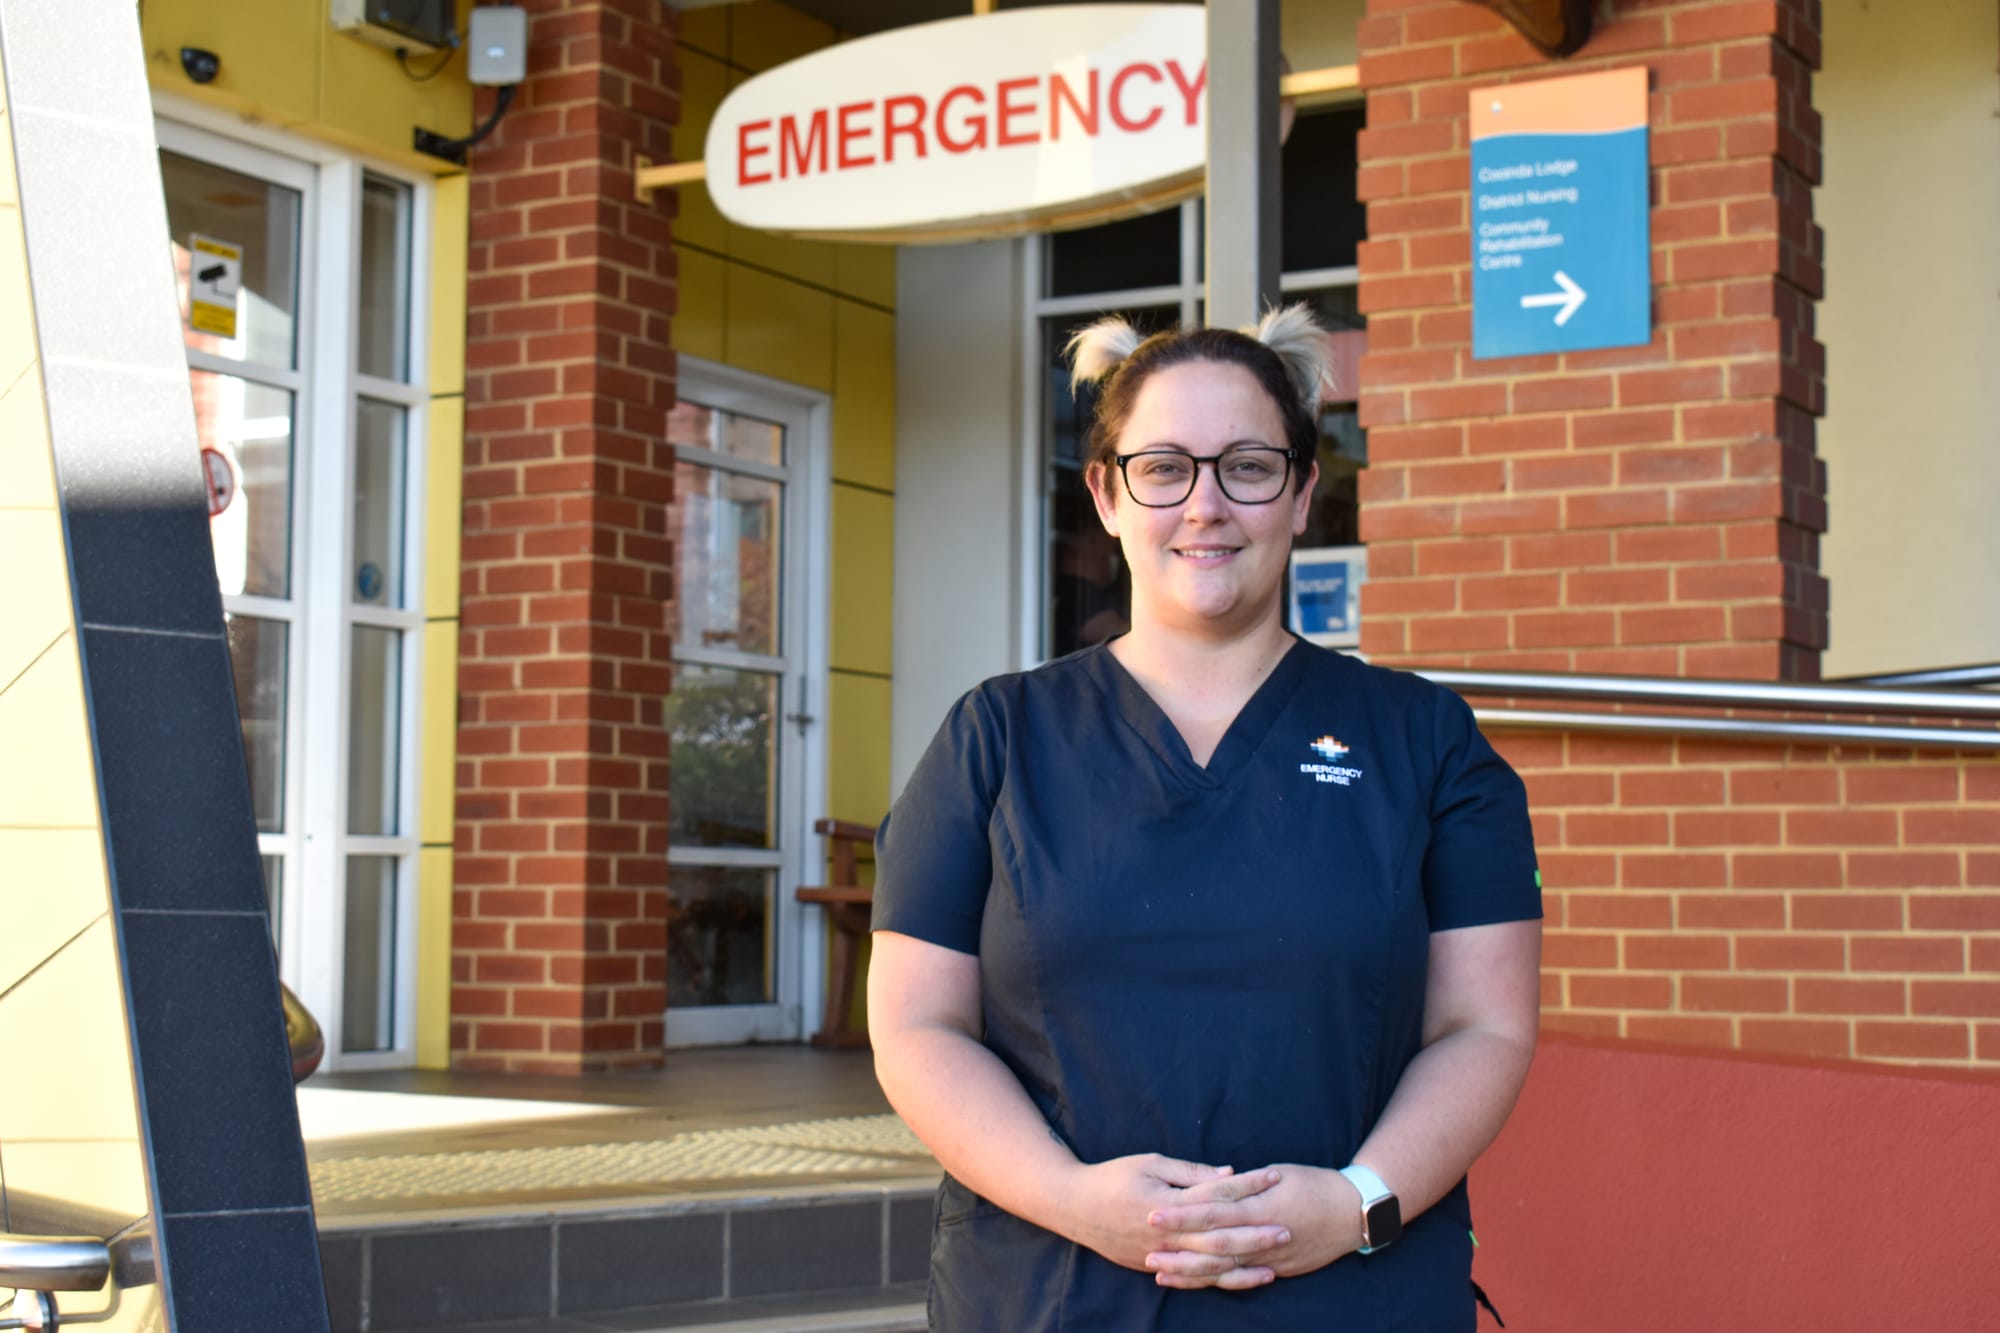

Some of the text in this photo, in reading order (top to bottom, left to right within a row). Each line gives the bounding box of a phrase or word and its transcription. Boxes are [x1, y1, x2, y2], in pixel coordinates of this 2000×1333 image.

[738, 59, 1207, 187] EMERGENCY
[1536, 160, 1578, 176] Lodge
[1479, 187, 1578, 210] District Nursing
[1479, 217, 1550, 237] Community
[1479, 233, 1564, 253] Rehabilitation
[1479, 254, 1523, 270] Centre
[1300, 764, 1362, 778] EMERGENCY
[1316, 774, 1350, 785] NURSE
